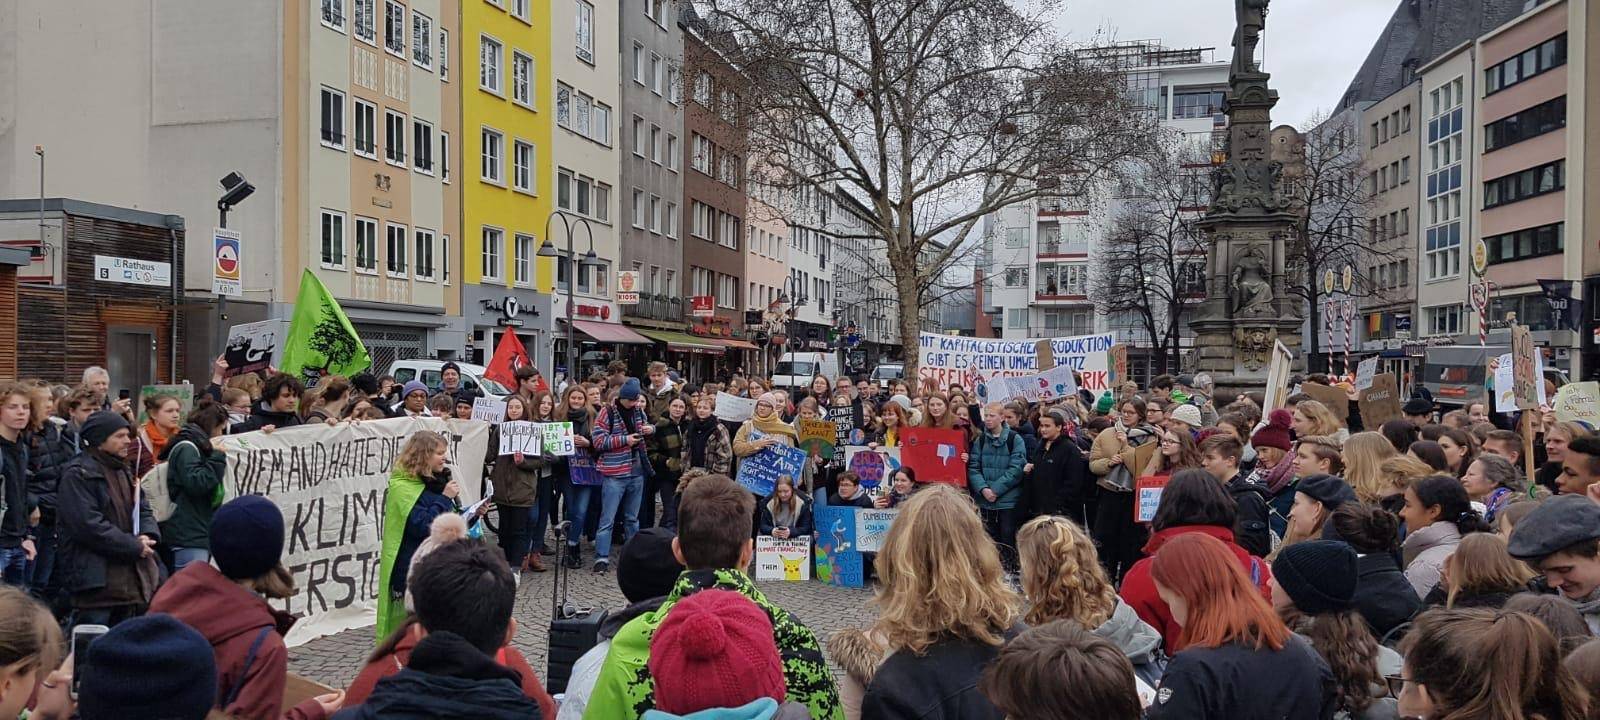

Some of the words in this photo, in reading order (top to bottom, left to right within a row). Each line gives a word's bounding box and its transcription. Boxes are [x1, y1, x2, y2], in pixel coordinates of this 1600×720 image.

[122, 260, 155, 271] Rathaus
[219, 285, 234, 294] Köln
[1051, 334, 1112, 354] RODUKTION
[926, 352, 950, 367] GIBT
[955, 355, 968, 369] ES
[972, 354, 1005, 370] KEINEN
[1082, 371, 1107, 390] RIK
[1366, 390, 1391, 402] CHANGE
[829, 407, 854, 416] CLIMATE
[829, 415, 854, 424] CHANGE
[234, 441, 327, 497] NIEMAND
[329, 436, 376, 479] HATTE
[381, 435, 405, 472] DIE
